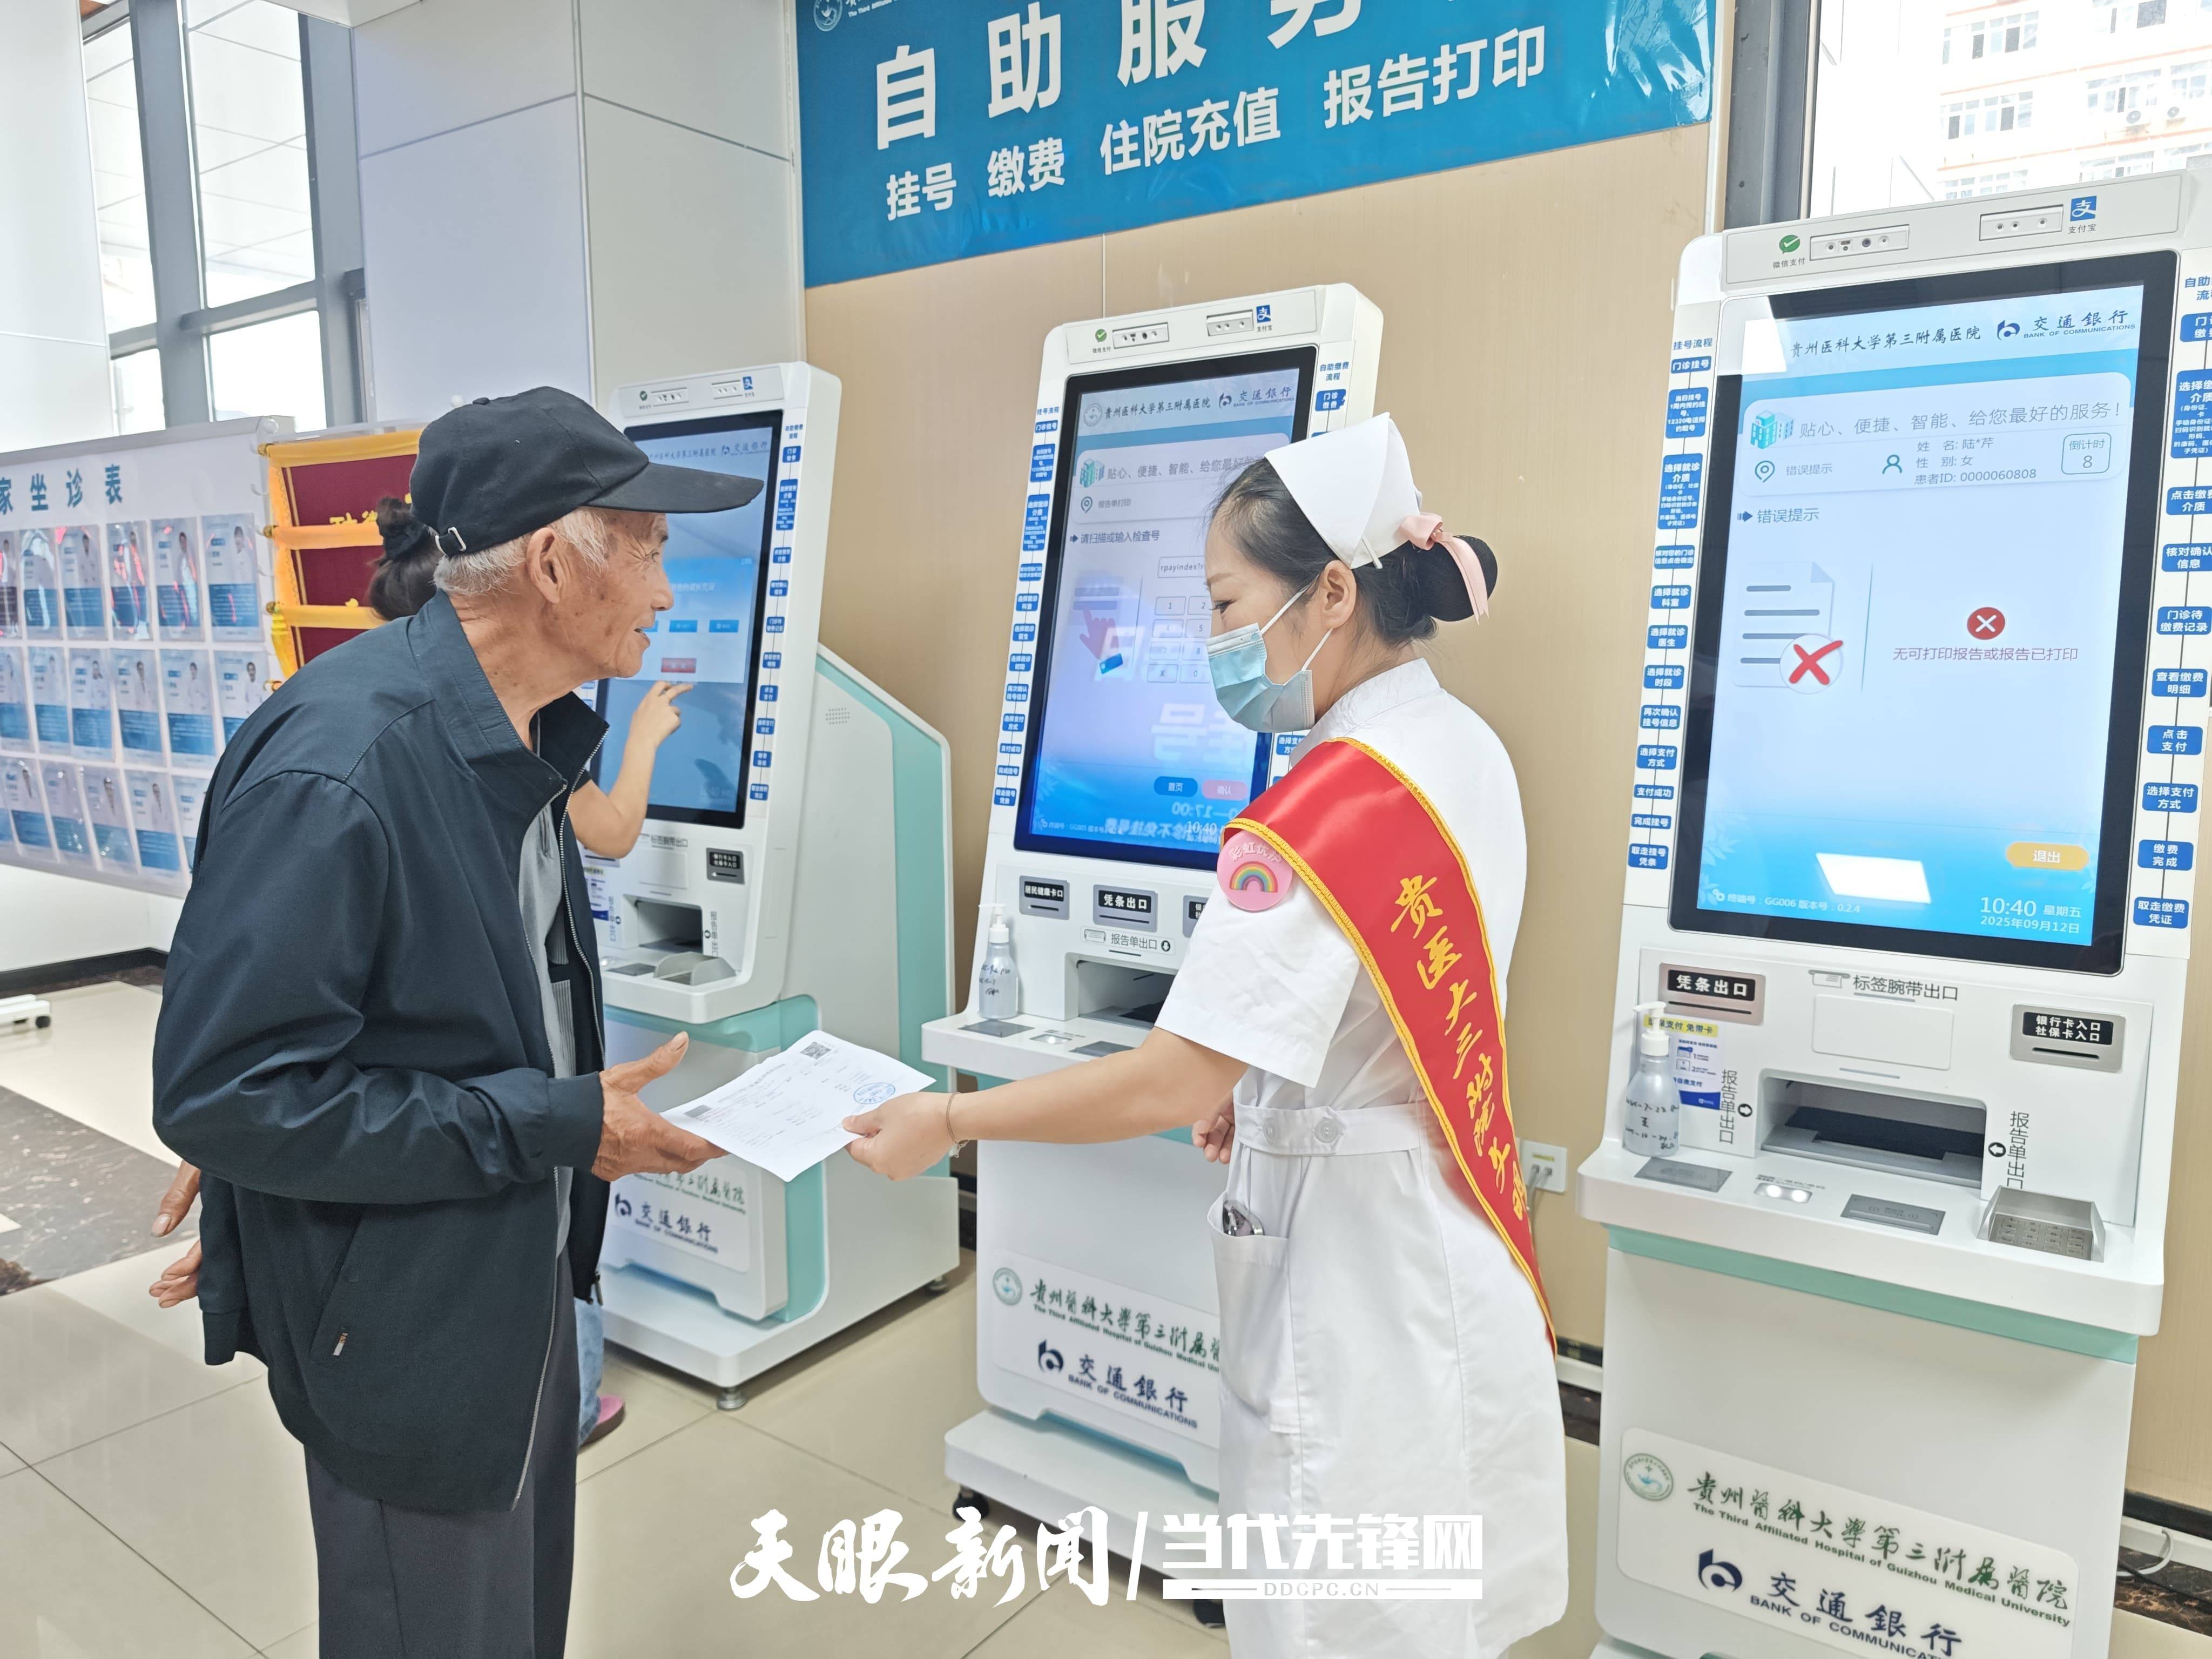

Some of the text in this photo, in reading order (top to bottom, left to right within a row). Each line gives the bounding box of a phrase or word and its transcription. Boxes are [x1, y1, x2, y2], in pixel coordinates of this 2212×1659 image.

[887, 25, 1545, 220] 挂号 缴费 住院充值 报告打印
[2068, 224, 2096, 234] 支付宝
[1772, 257, 1805, 269] 微信支付
[2063, 324, 2135, 335] COMMUNICATIONS
[1673, 338, 1713, 350] 挂号流程
[1790, 325, 1981, 358] 贵州医科大学第三附属医院
[1673, 359, 1710, 371] 门诊挂号
[1917, 441, 1930, 453] 姓
[2069, 438, 2105, 451] 倒计时
[1916, 457, 1929, 468] 性
[1961, 455, 1973, 467] 女
[2082, 455, 2093, 469] 8
[1785, 463, 1833, 476] 错误提示
[1960, 468, 2037, 482] 0000060808
[1098, 498, 1131, 509] 报告单打印
[2182, 501, 2206, 512] 介质
[1757, 507, 1820, 524] 错误提示
[2177, 558, 2201, 569] 信息
[1654, 588, 1689, 597] 选择就诊
[2167, 610, 2203, 621] 门诊待
[1650, 628, 1685, 637] 选择就诊
[2160, 621, 2208, 632] 缴费记录
[1658, 638, 1675, 647] 医生
[1893, 646, 2078, 663] 无可打印报告或报告已打印
[1647, 667, 1682, 677] 选择就诊
[2156, 671, 2204, 683] 查看缴费
[1655, 678, 1672, 687] 时段
[2167, 684, 2191, 695] 明细
[1643, 707, 1678, 717] 再次确认
[2162, 729, 2188, 740] 点击
[2162, 741, 2187, 752] 支付
[1640, 748, 1675, 758] 选择支付
[1648, 759, 1665, 767] 方式
[1168, 782, 1184, 793] 首页
[1637, 787, 1671, 797] 支付成功
[2147, 785, 2195, 798] 选择支付
[2157, 798, 2182, 810] 方式
[1634, 817, 1668, 827] 完成挂号
[1631, 846, 1666, 857] 取走挂号
[2154, 843, 2179, 855] 缴费
[2033, 850, 2061, 865] 退出
[2153, 855, 2178, 868] 完成
[1103, 894, 1148, 910] 凭条出口
[1980, 896, 2082, 918] 10:40 星期五
[2137, 900, 2186, 914] 取走缴费
[1980, 915, 2080, 934] 2025年09月12日
[2148, 913, 2173, 926] 凭证
[1111, 933, 1157, 950] 报告单出口
[1676, 974, 1748, 997] 凭条出口
[1853, 975, 1958, 1001] 标签腕带出口
[2036, 1015, 2100, 1031] 银行卡入口
[2035, 1026, 2100, 1042] 社保卡入口
[1719, 1069, 1737, 1144] 报告单出口
[2007, 1110, 2029, 1189] 报告单出口
[1034, 1304, 1046, 1313] The
[1048, 1308, 1065, 1321] Third
[1103, 1327, 1132, 1344] Hospital
[1144, 1341, 1173, 1358] Guizhou
[1176, 1352, 1206, 1368] Medical
[1068, 1374, 1198, 1429] BANK OF COMMUNICATIONS
[1693, 1502, 2071, 1627] The Third Affiliated Hospital of Guizhou Medical University
[1750, 1595, 1946, 1659] BANK OF COMMUNICAT
